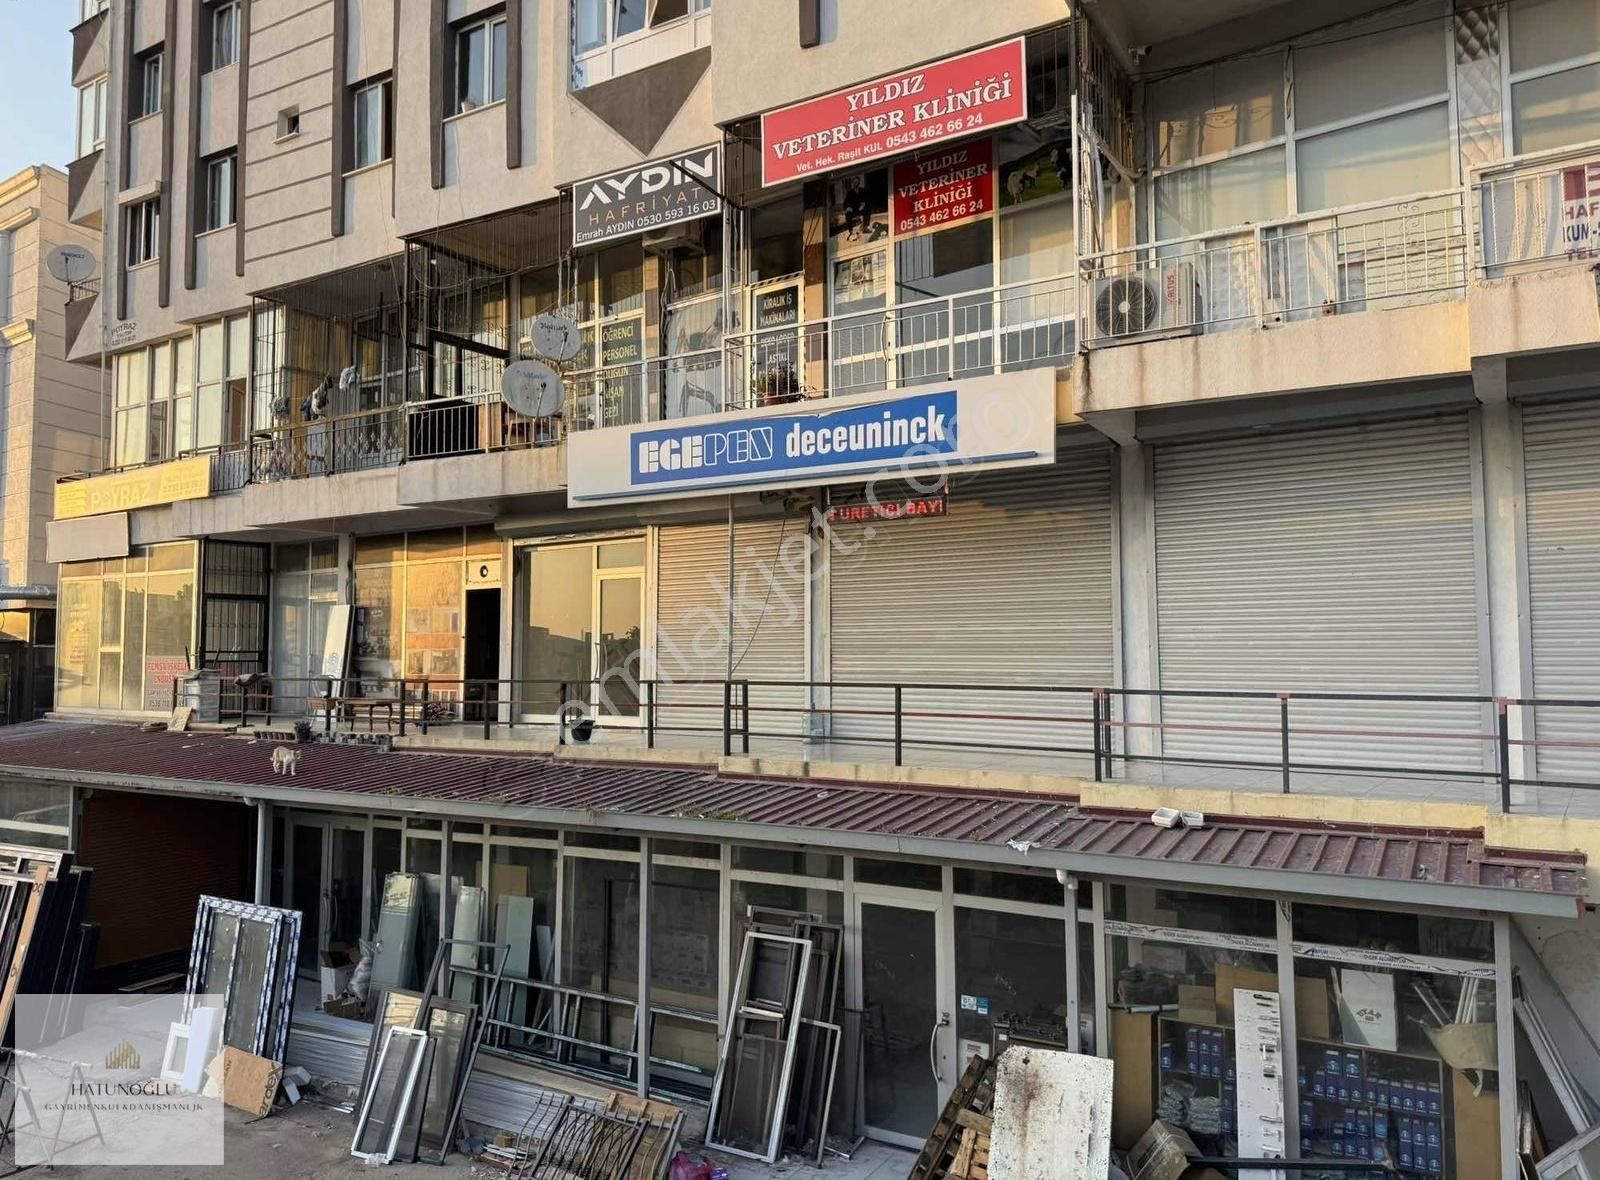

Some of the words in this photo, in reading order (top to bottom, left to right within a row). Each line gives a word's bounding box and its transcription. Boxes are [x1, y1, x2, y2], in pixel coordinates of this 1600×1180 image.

[846, 74, 926, 111] YILDIZ
[772, 111, 906, 160] VETERİNER
[913, 72, 1013, 122] KLİNİĞİ
[796, 159, 814, 172] Vet.
[815, 154, 836, 169] Hek.
[863, 143, 883, 155] KUL
[886, 131, 917, 149] 0543
[920, 124, 943, 139] 462
[946, 119, 963, 132] 66
[967, 112, 984, 127] 24
[579, 151, 713, 211] AYDIN
[899, 163, 988, 198] VETERİNER
[917, 150, 968, 175] YILDIZ
[588, 187, 701, 226] HAFRİYAT
[901, 215, 926, 231] 0543
[929, 208, 950, 222] 462
[952, 203, 966, 217] 66
[969, 199, 984, 213] 24
[913, 182, 973, 213] KLİNİĞİ
[577, 229, 603, 242] Emrah
[605, 219, 635, 235] AYDIN
[637, 213, 662, 227] 0530
[665, 207, 684, 220] 593
[687, 204, 700, 215] 16
[702, 199, 716, 211] 03
[602, 346, 638, 362] PERSONEL
[639, 426, 773, 473] EGEPEN
[786, 405, 945, 457] deceuninck
